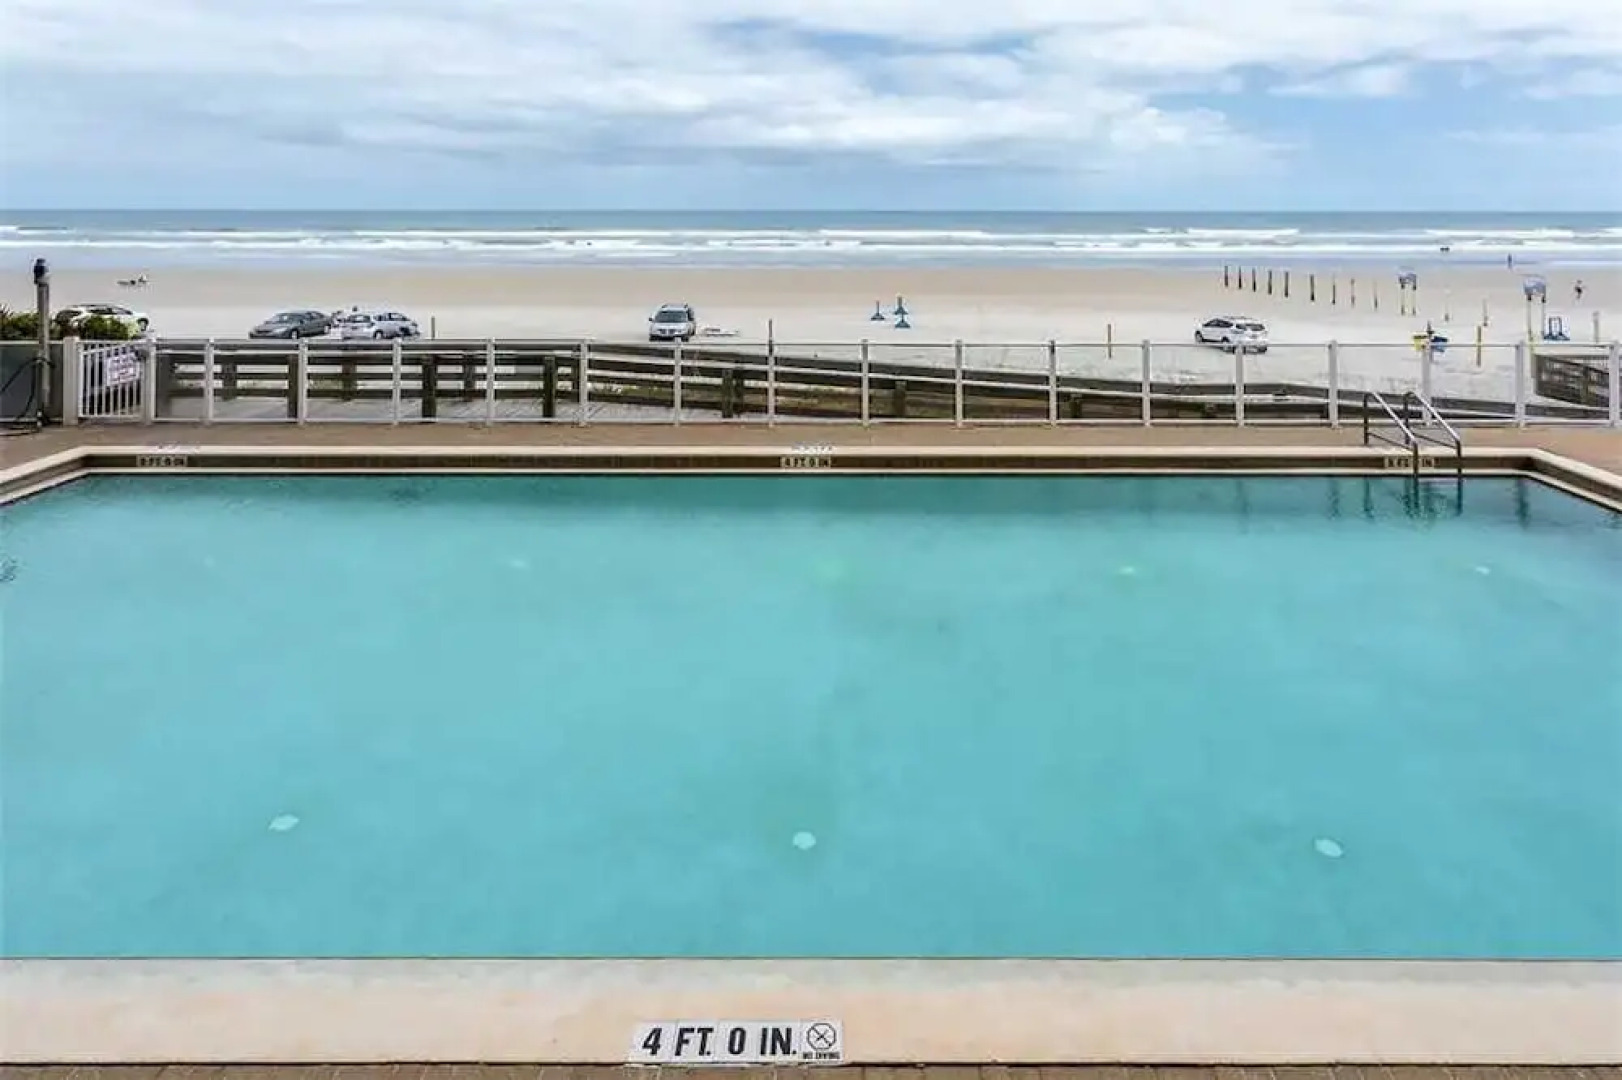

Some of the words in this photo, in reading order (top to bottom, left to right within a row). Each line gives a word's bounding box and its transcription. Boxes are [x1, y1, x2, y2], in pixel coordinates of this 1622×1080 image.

[641, 1027, 662, 1055] 4
[674, 1027, 714, 1057] FT.
[727, 1027, 746, 1055] 0
[760, 1027, 797, 1056] IN.
